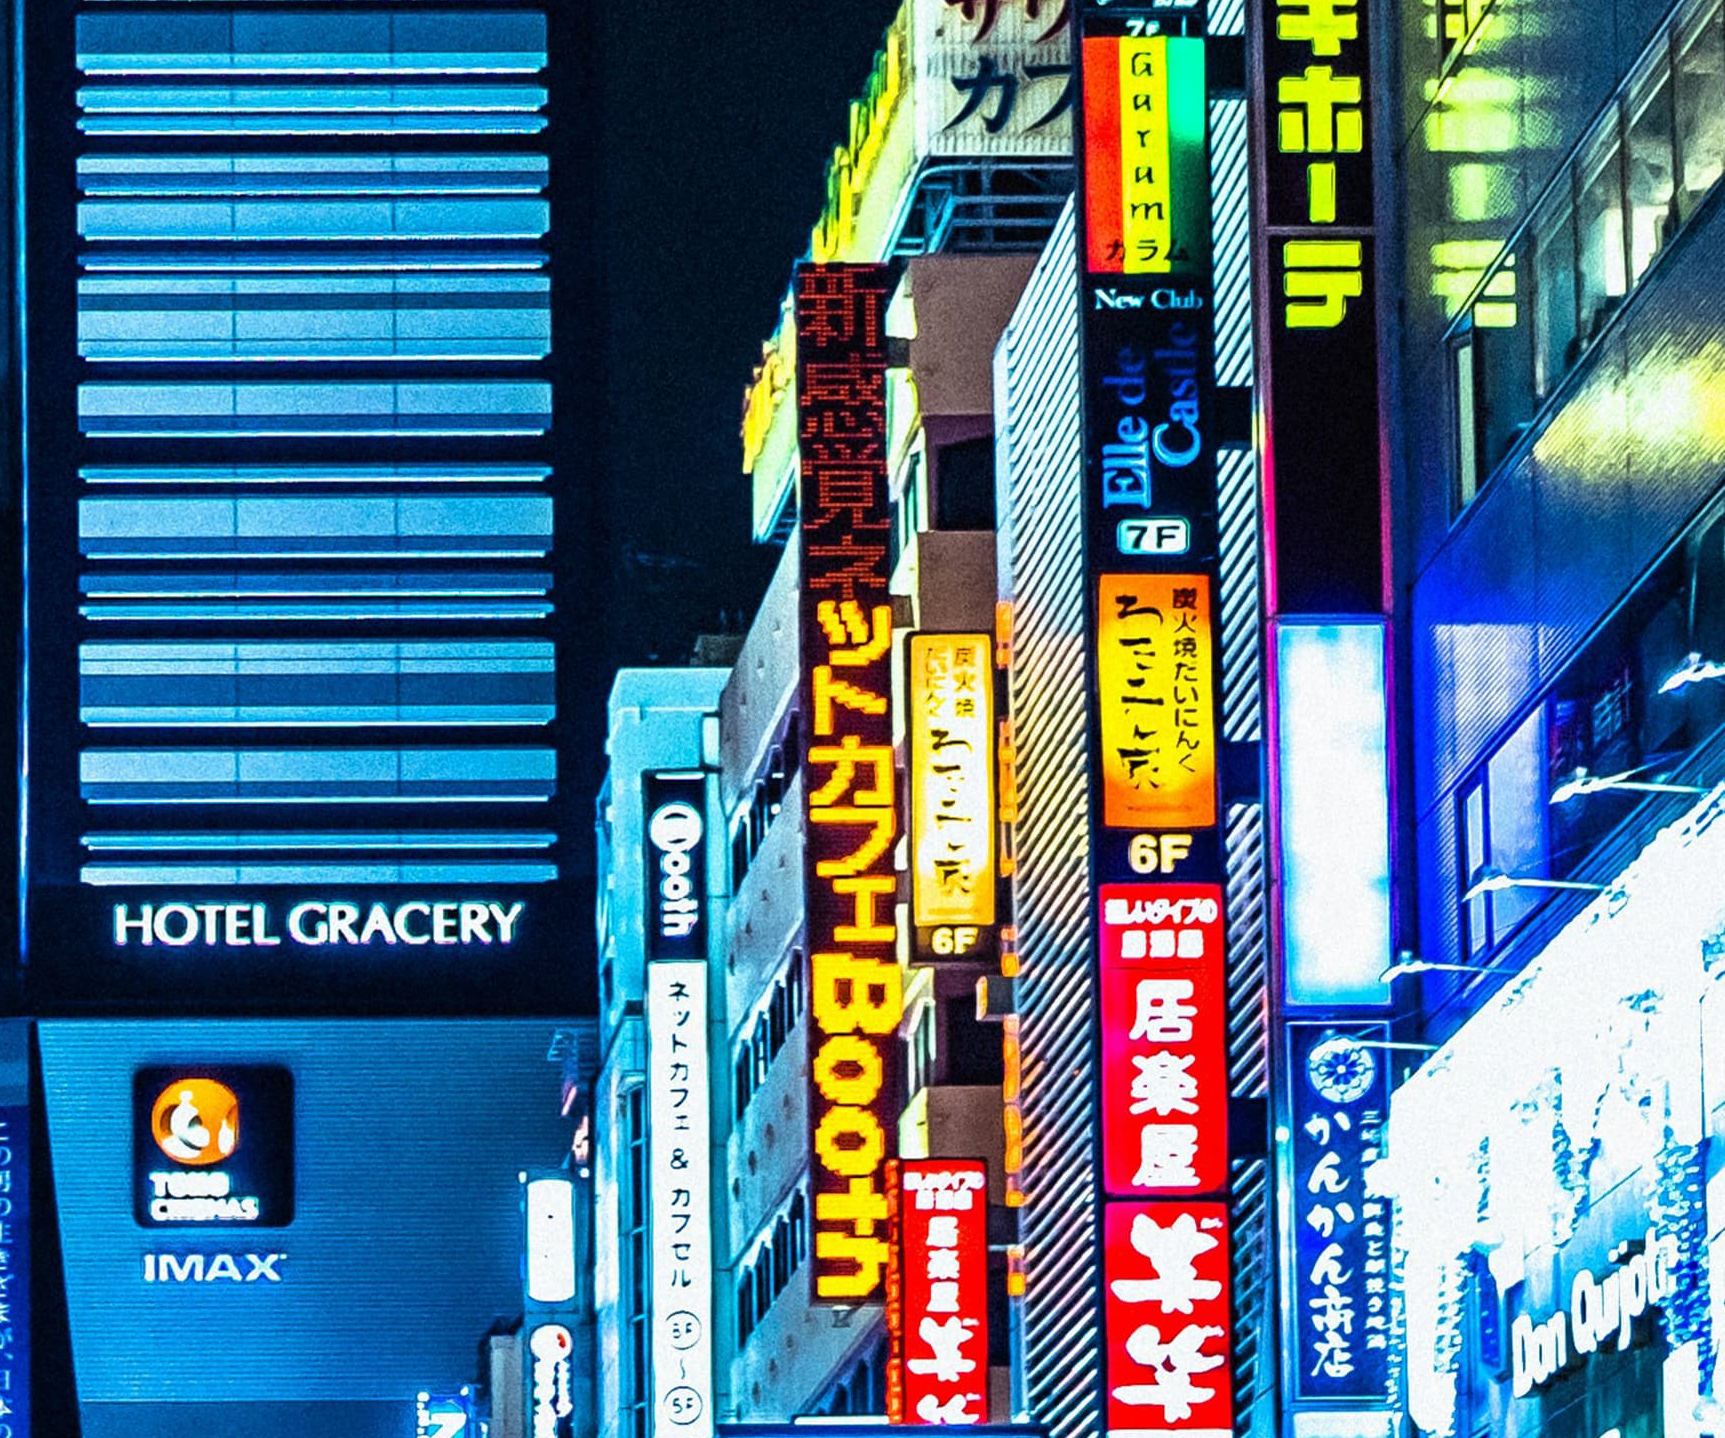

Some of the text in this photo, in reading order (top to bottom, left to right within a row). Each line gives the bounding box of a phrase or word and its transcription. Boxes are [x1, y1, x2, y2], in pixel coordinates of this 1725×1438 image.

[1096, 287, 1205, 311] New Club
[1102, 416, 1151, 509] Elle
[1126, 525, 1181, 548] 7F
[649, 802, 704, 937] ooth
[1128, 833, 1193, 873] 6F
[113, 901, 523, 946] HOTEL GRACERY
[932, 926, 976, 955] 6F
[670, 981, 690, 1130] ネットカフェ
[1128, 977, 1201, 1188] 居楽屋
[142, 1253, 281, 1282] IMAX
[1304, 1111, 1355, 1377] かんかん商店
[1512, 1311, 1567, 1399] Don
